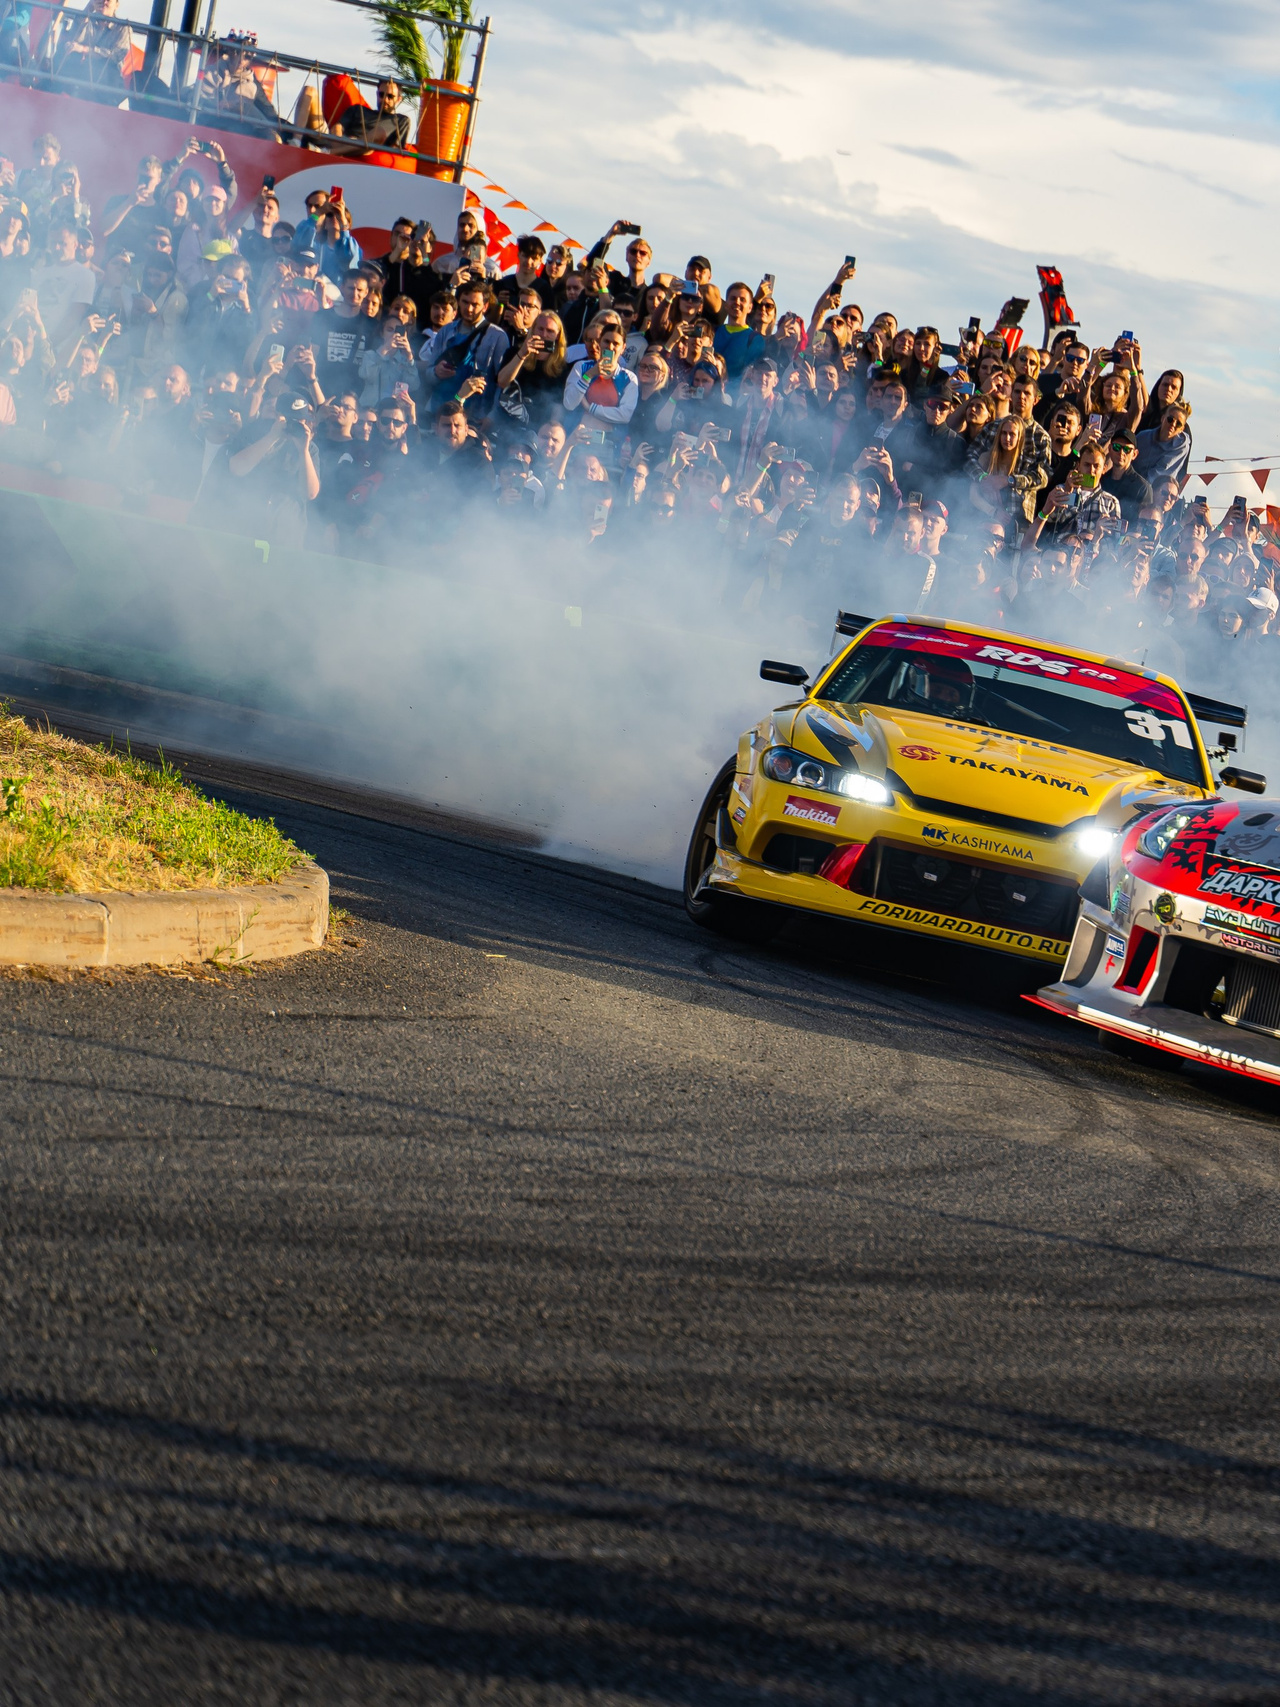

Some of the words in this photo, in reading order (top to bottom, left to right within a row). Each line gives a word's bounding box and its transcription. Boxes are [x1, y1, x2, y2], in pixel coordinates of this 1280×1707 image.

[975, 645, 1079, 675] RDS
[1078, 667, 1118, 682] GP
[1124, 709, 1194, 750] 31
[945, 753, 1090, 797] TAKAYAMA
[1029, 768, 1067, 780] MOTOR
[921, 825, 950, 842] MK
[951, 832, 1034, 862] KASHIYAMA
[857, 899, 1070, 957] FORWARDAUTO.RU
